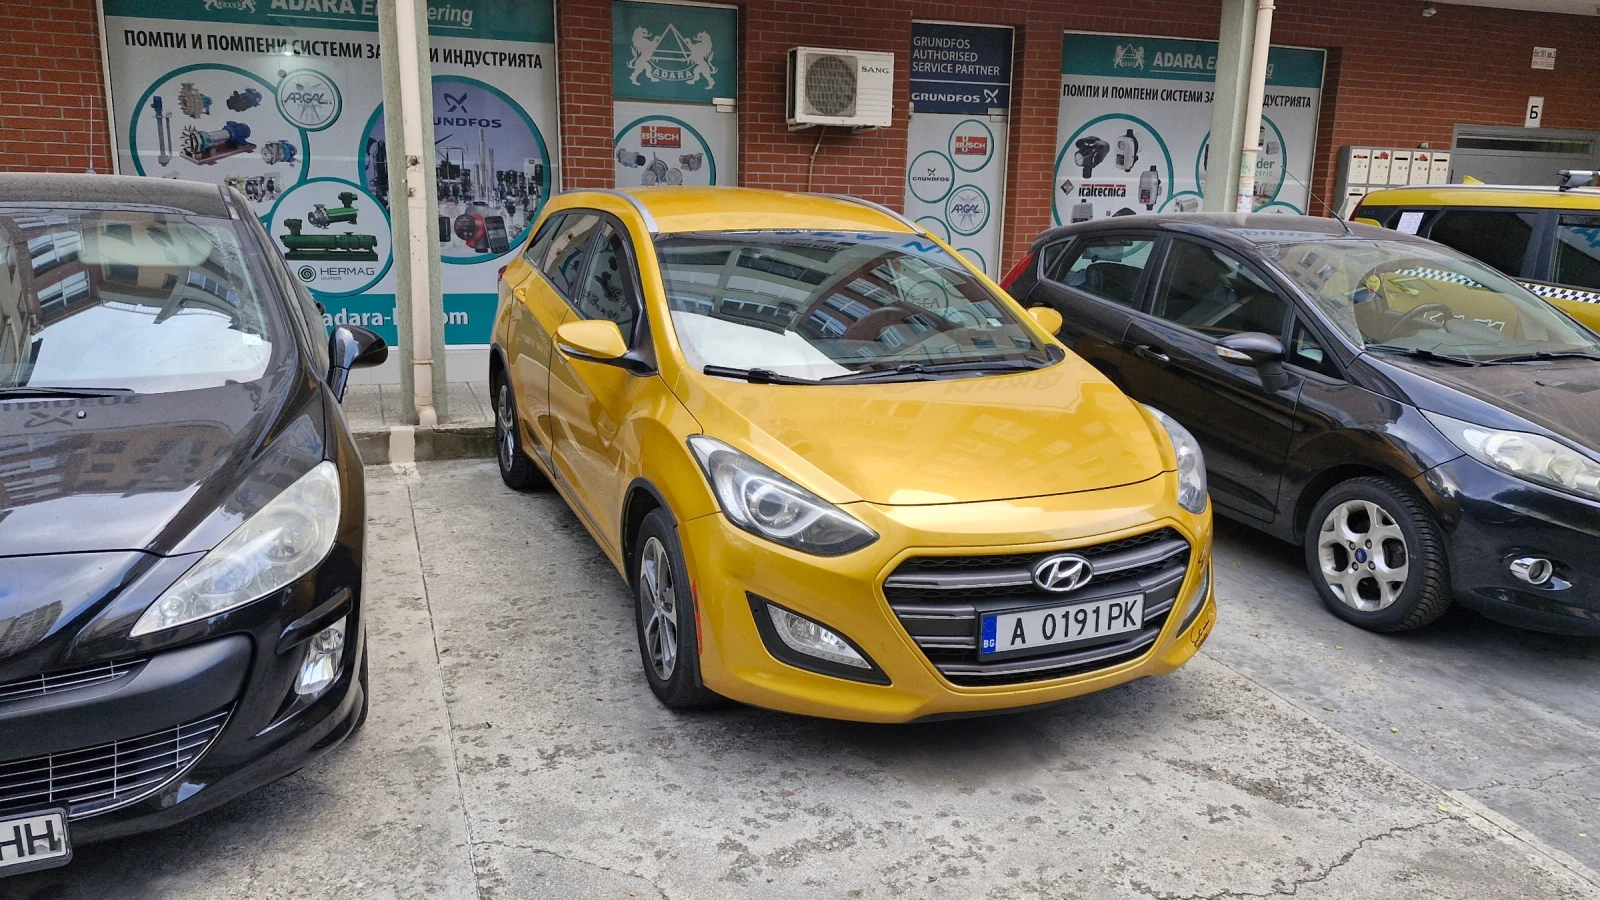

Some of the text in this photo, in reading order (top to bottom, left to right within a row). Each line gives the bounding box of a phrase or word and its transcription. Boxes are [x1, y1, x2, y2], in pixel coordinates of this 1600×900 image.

[913, 36, 971, 49] GRUNDFOS
[124, 30, 187, 49] ПОМПИ
[191, 33, 203, 50] И
[207, 34, 287, 54] ПОМПЕНИ
[293, 39, 363, 59] СИСТЕМИ
[443, 50, 543, 69] ИНДУСТРИЯТА
[912, 49, 979, 62] AUTHORISED
[1153, 52, 1204, 69] ADARA
[652, 69, 694, 79] ADARA
[912, 62, 1000, 76] SERVICE PARTNER
[911, 92, 980, 103] GRUNDFOS
[1063, 84, 1100, 98] ПОМПИ
[1102, 86, 1109, 98] И
[1111, 87, 1159, 101] ПОМПЕНИ
[1160, 89, 1203, 103] СИСТЕМИ
[1262, 94, 1311, 108] ДУСТРИЯТА
[1529, 105, 1539, 119] Б
[432, 116, 502, 129] UNDFOS
[642, 131, 680, 142] BUSCH
[955, 140, 987, 150] BUSCH
[320, 267, 375, 276] HERMAG
[1010, 617, 1027, 646] A
[983, 639, 995, 648] BG
